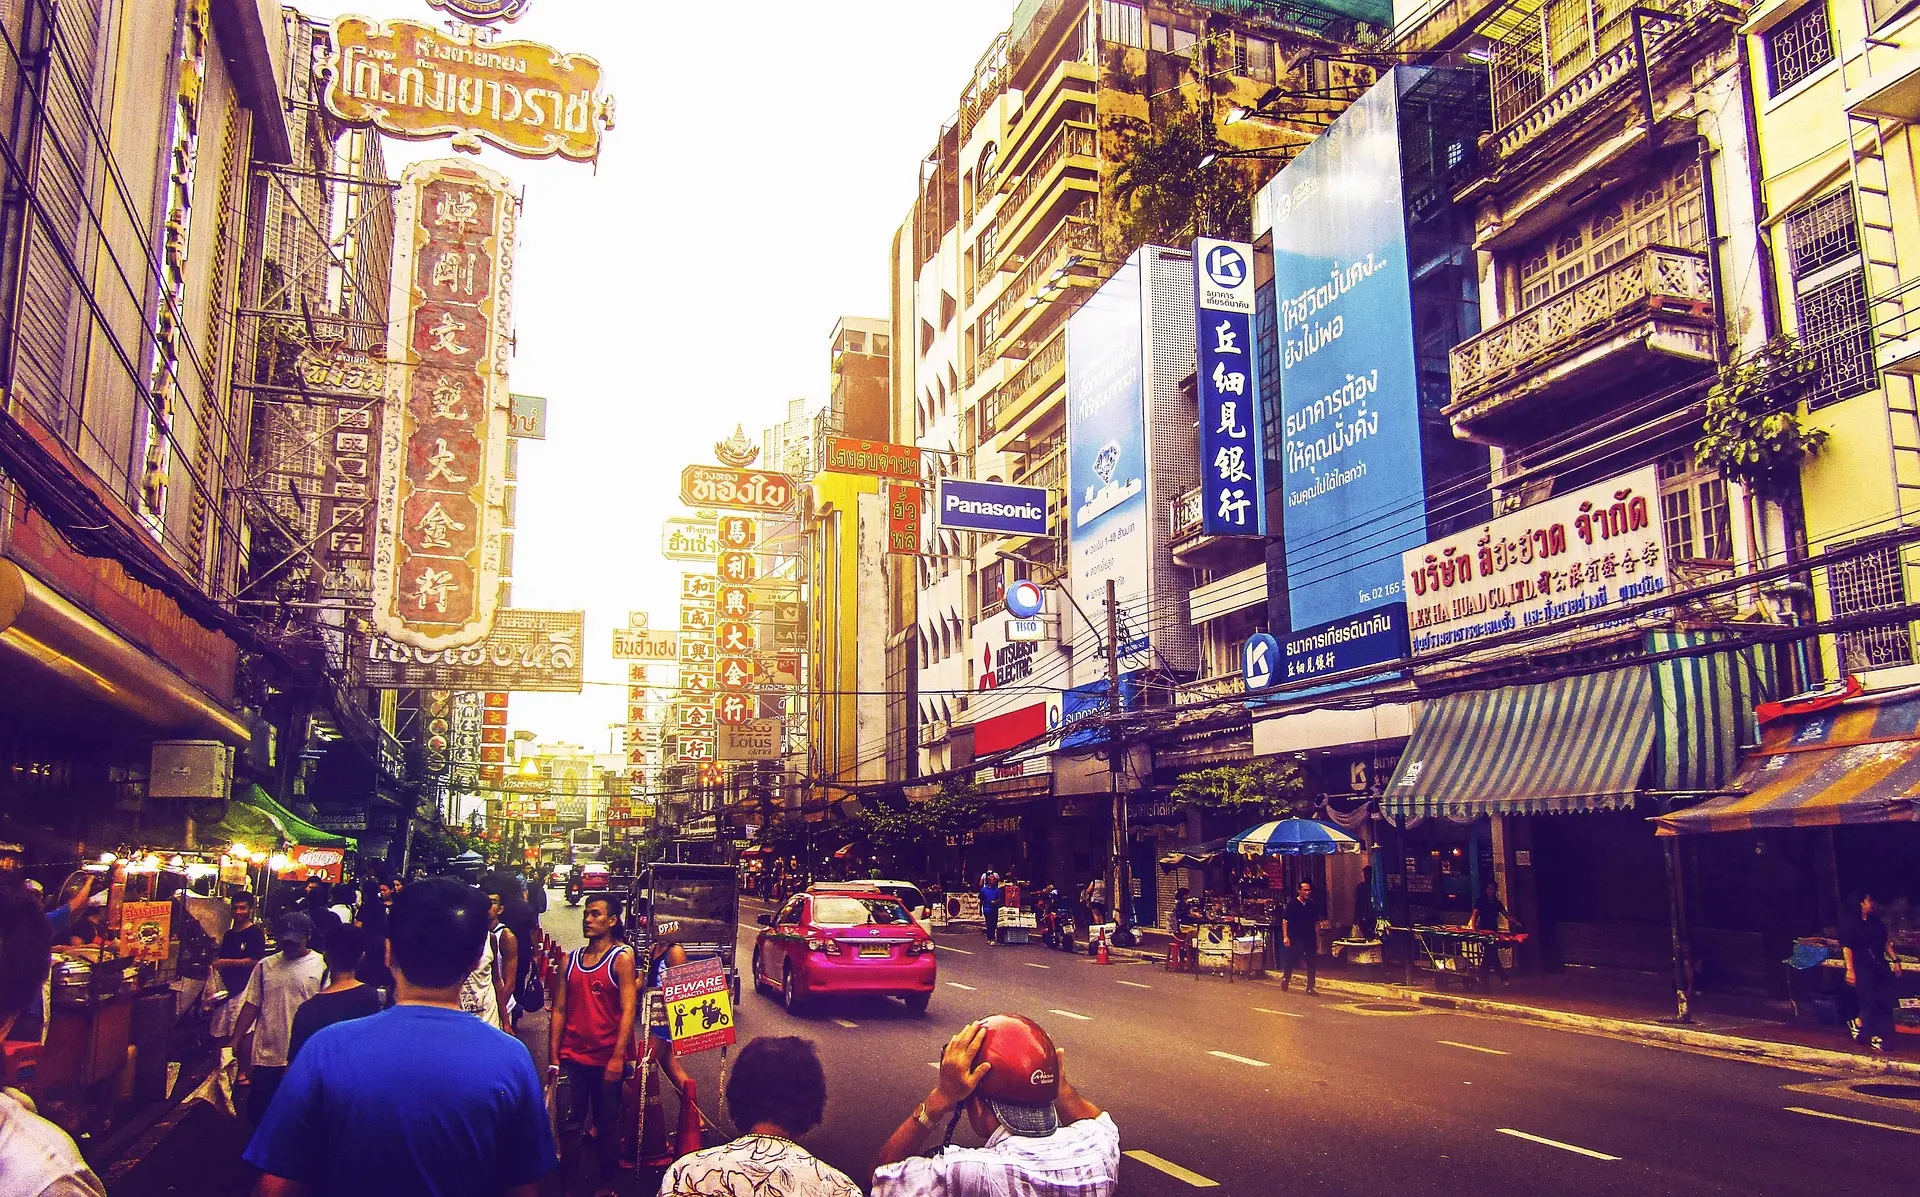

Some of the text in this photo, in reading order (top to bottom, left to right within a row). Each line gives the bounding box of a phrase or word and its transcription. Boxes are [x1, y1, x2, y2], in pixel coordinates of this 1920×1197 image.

[415, 35, 527, 73] ห้างขายทอง
[1206, 290, 1235, 300] ธนาคาร
[1206, 297, 1250, 309] เกียรตินาคิน
[1285, 315, 1344, 370] ยังไม่พอ
[1287, 369, 1378, 437] ธนาคารต้อง
[1213, 320, 1252, 526] 丘細見銀行
[1287, 400, 1378, 474] ให้คุณมั่งคั่ง
[827, 440, 919, 476] โรงรับจำนำ
[693, 469, 738, 482] ห้างทอง
[692, 475, 786, 506] ทองใบ
[946, 494, 1042, 521] Panasonic
[891, 525, 916, 550] หลี
[1411, 546, 1472, 596] บริษัท
[1574, 488, 1649, 545] จำกัด
[1372, 587, 1383, 599] 02
[1385, 581, 1400, 596] 165
[723, 520, 747, 721] 馬利興大金行
[1016, 621, 1037, 632] TISCO
[1409, 607, 1431, 631] LEE
[1432, 603, 1451, 625] HA
[1452, 593, 1487, 620] HUAD
[1286, 614, 1391, 656] ธนาคารเกียรตินาคิน
[687, 578, 709, 758] 和成興大金行
[996, 640, 1038, 668] MITSUBISHI
[1287, 651, 1336, 678] 丘細見銀行
[996, 656, 1033, 687] ELECTRIC
[630, 665, 645, 784] 振和興大金行
[730, 724, 772, 732] TESCO
[730, 736, 772, 748] Lotus
[608, 810, 620, 820] 24
[665, 975, 723, 997] BEWARE
[665, 994, 676, 1003] OF
[706, 984, 725, 993] THIEF
